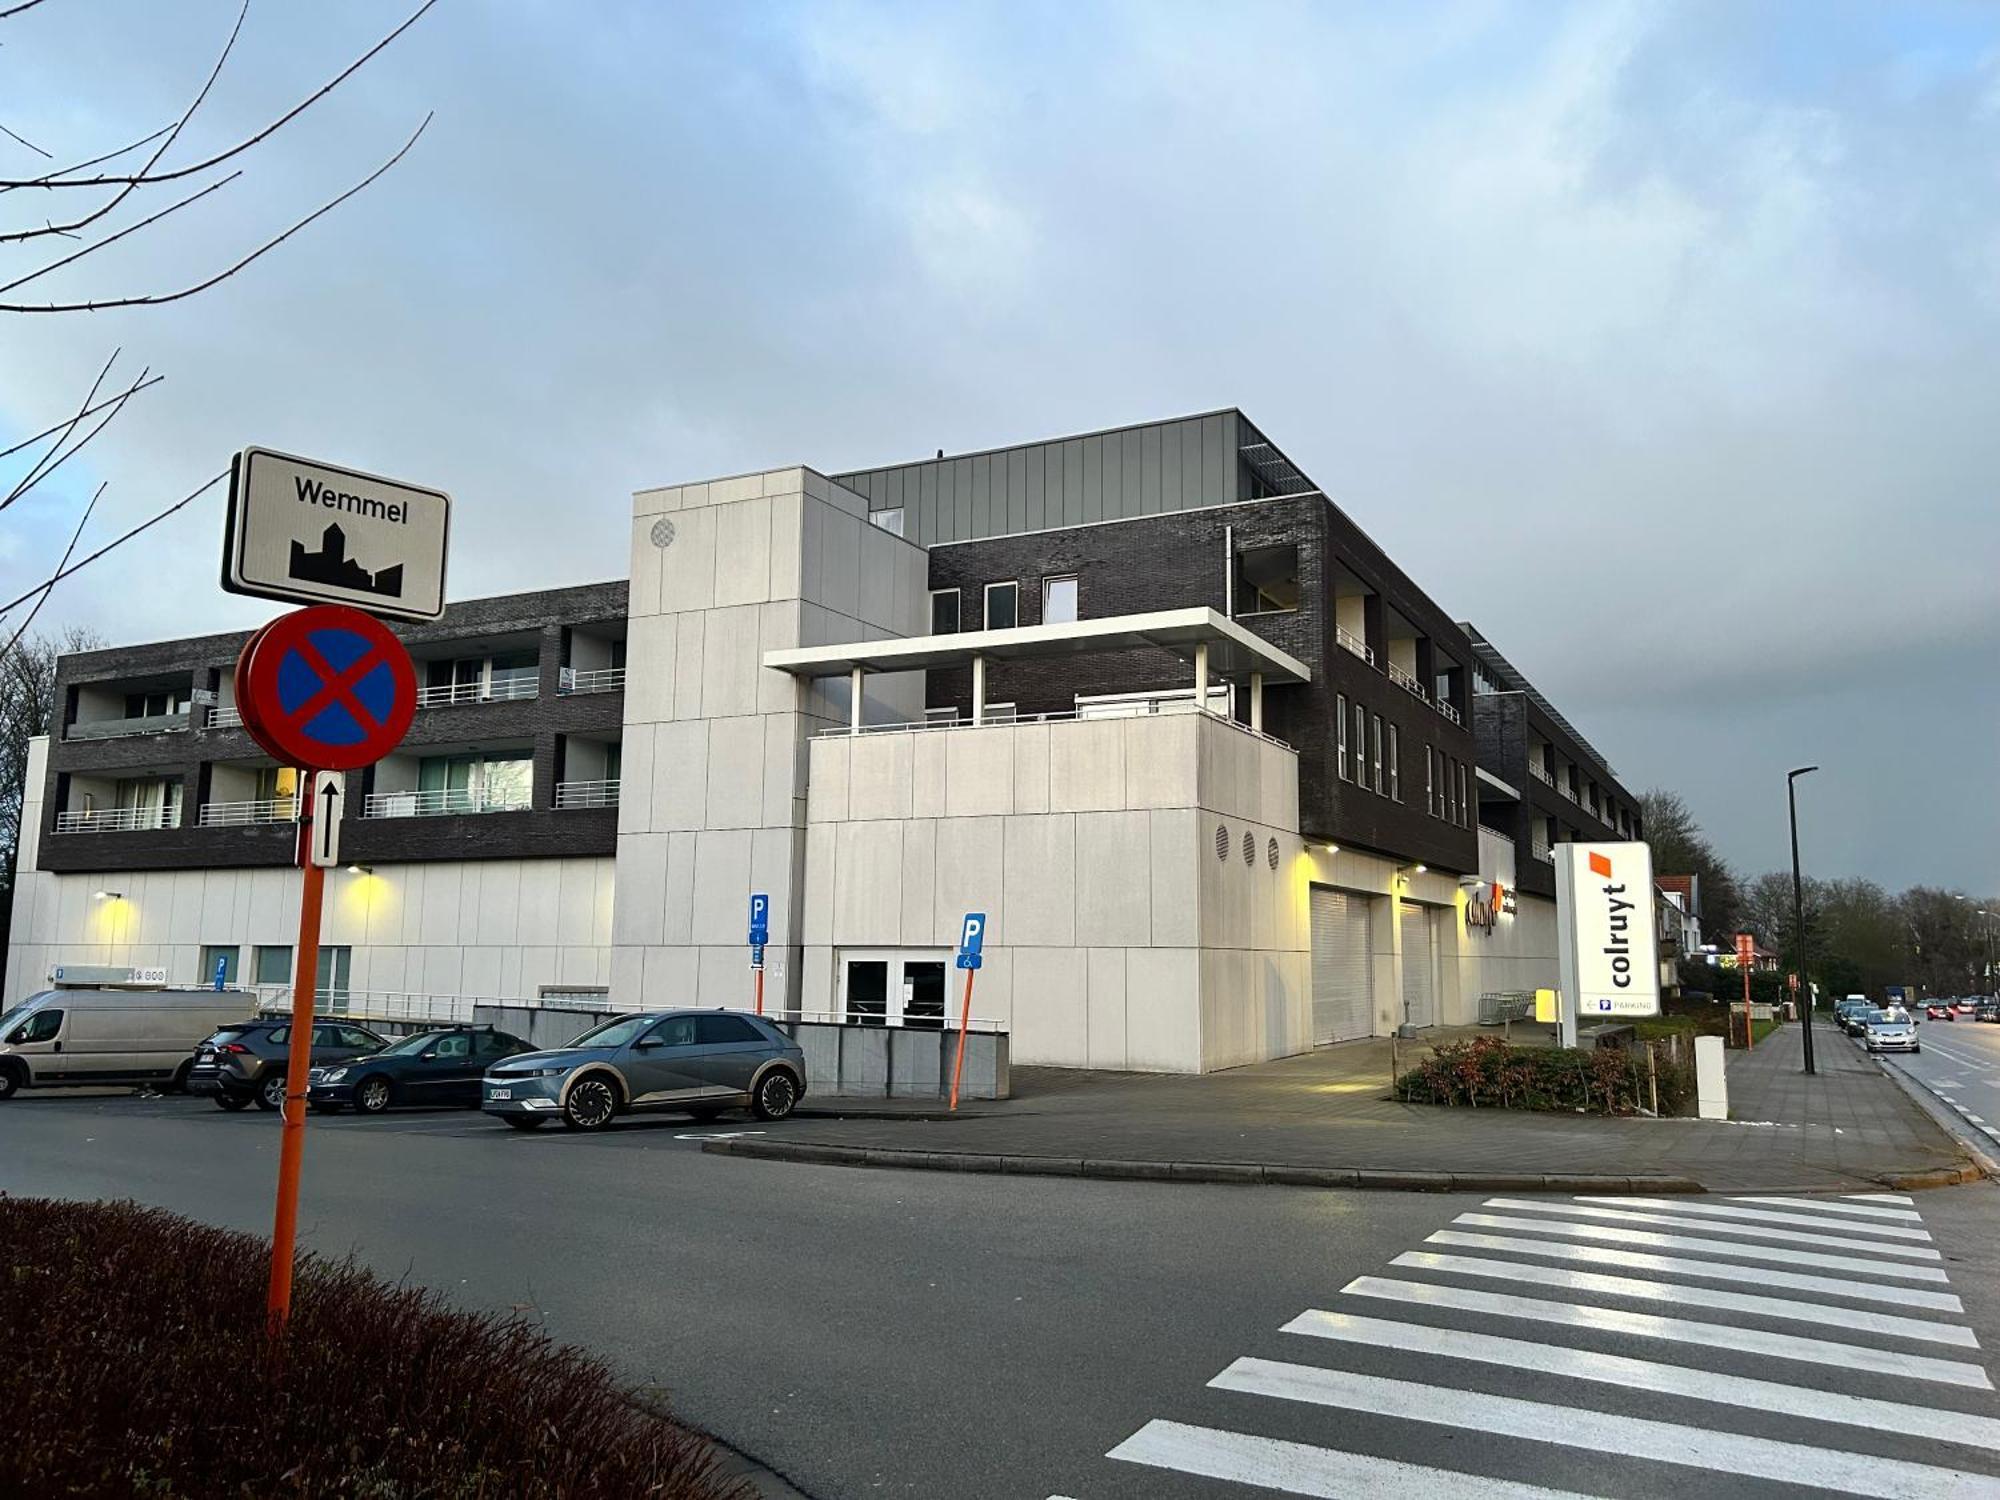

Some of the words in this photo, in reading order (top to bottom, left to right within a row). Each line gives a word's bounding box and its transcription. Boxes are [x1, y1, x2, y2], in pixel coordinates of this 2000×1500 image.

[294, 475, 408, 525] Wemmel
[753, 899, 764, 921] P
[963, 919, 981, 948] P
[1602, 883, 1636, 989] colruyt
